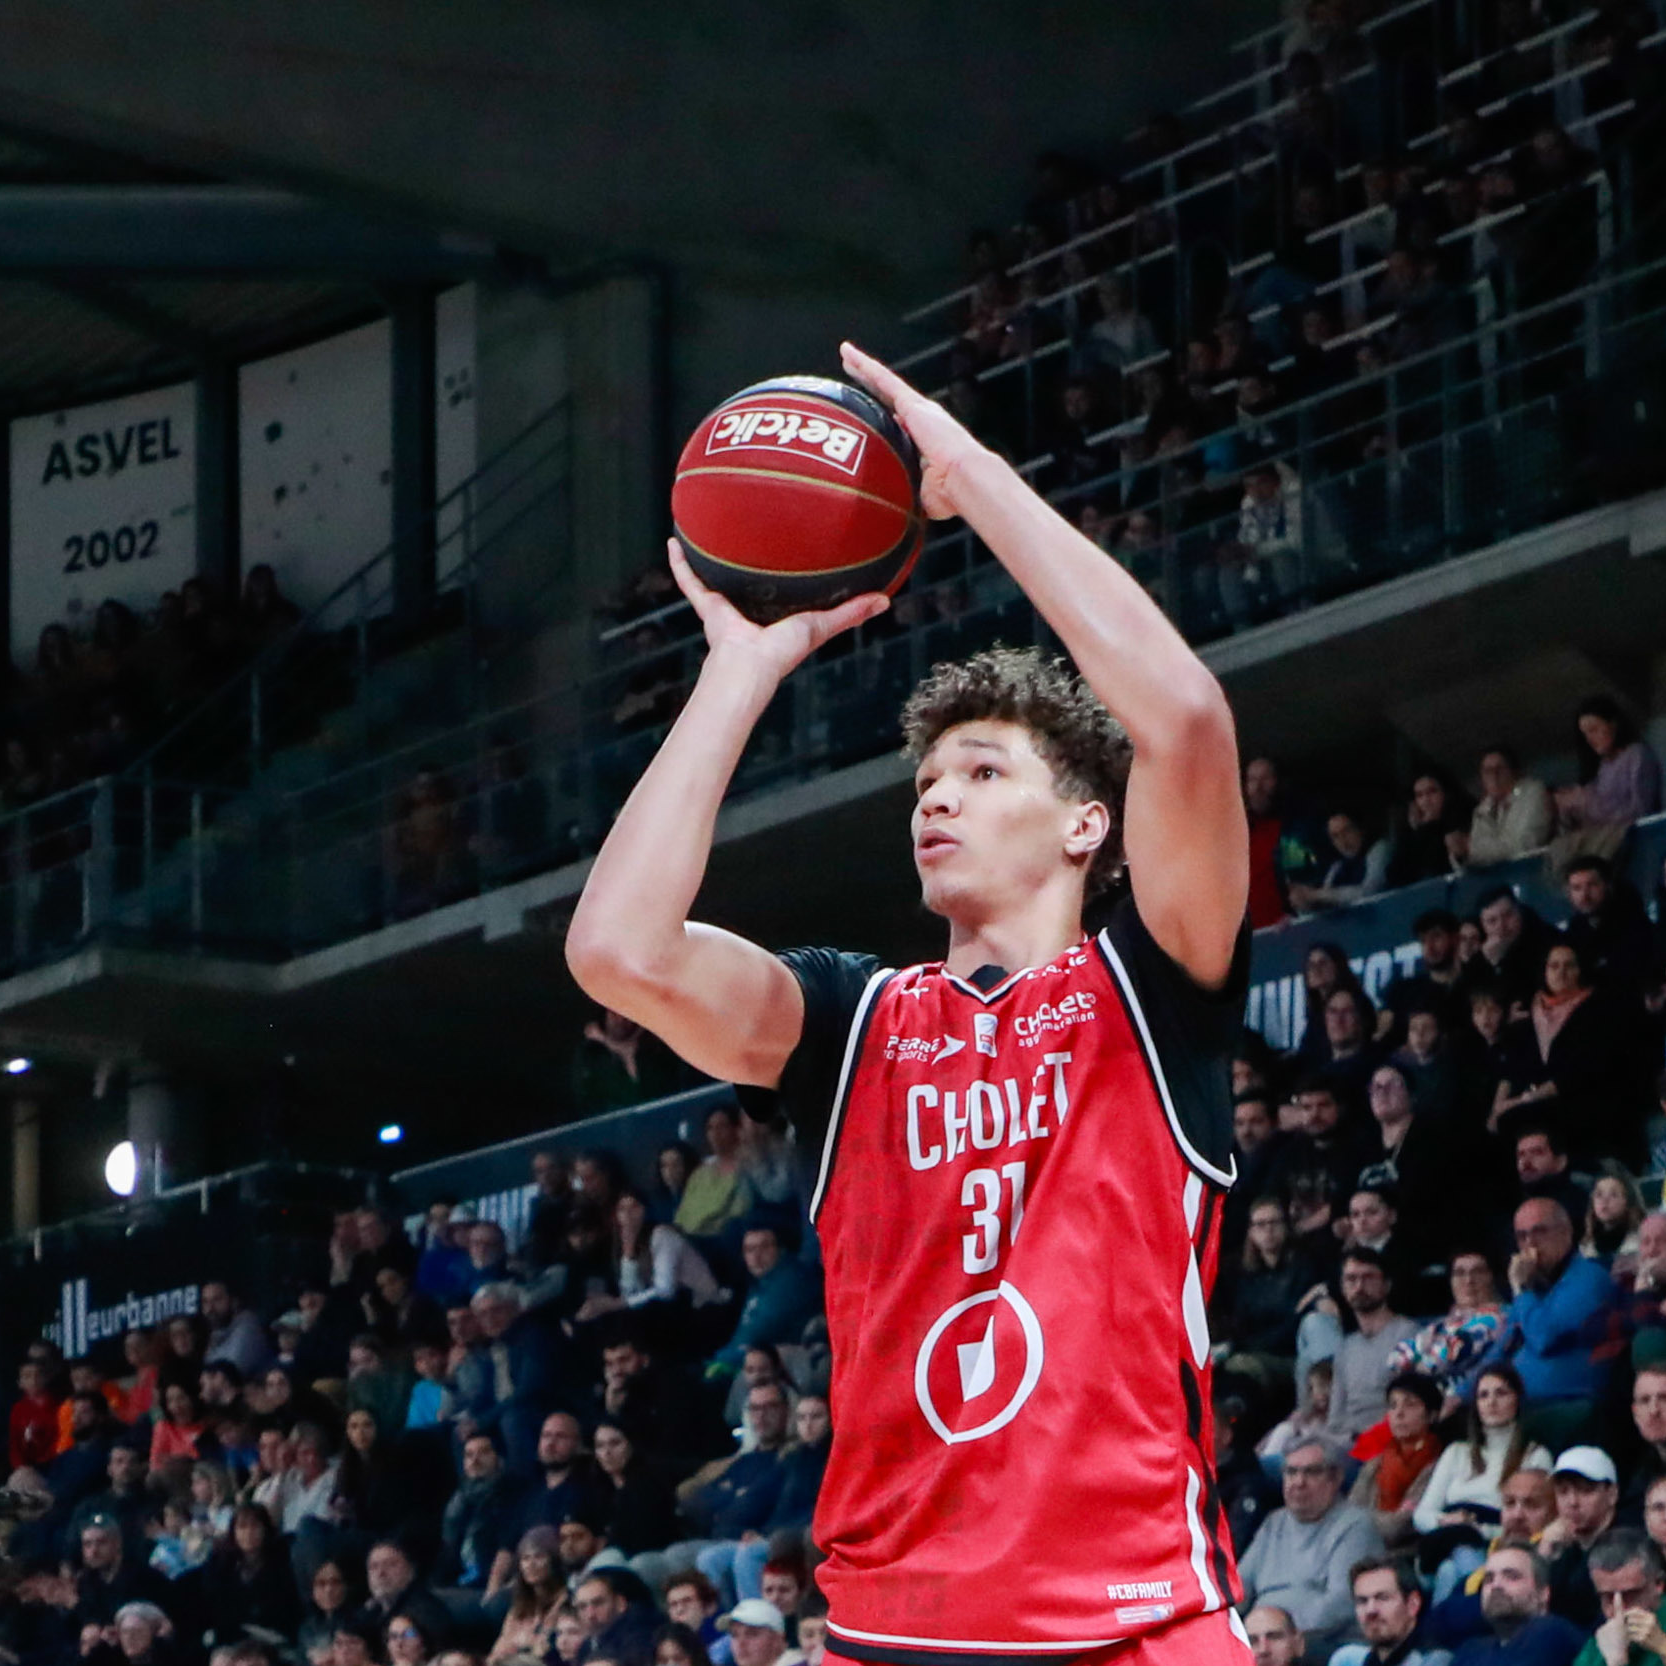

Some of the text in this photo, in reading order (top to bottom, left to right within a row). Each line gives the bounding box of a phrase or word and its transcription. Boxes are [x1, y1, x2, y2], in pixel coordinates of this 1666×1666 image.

[41, 417, 181, 486] ASVEL
[715, 412, 860, 463] Betclic
[64, 520, 160, 575] 2002
[906, 1051, 1073, 1172] CHOLET
[960, 1161, 1026, 1275] 31
[1106, 1581, 1173, 1600] #CBFAMILY
